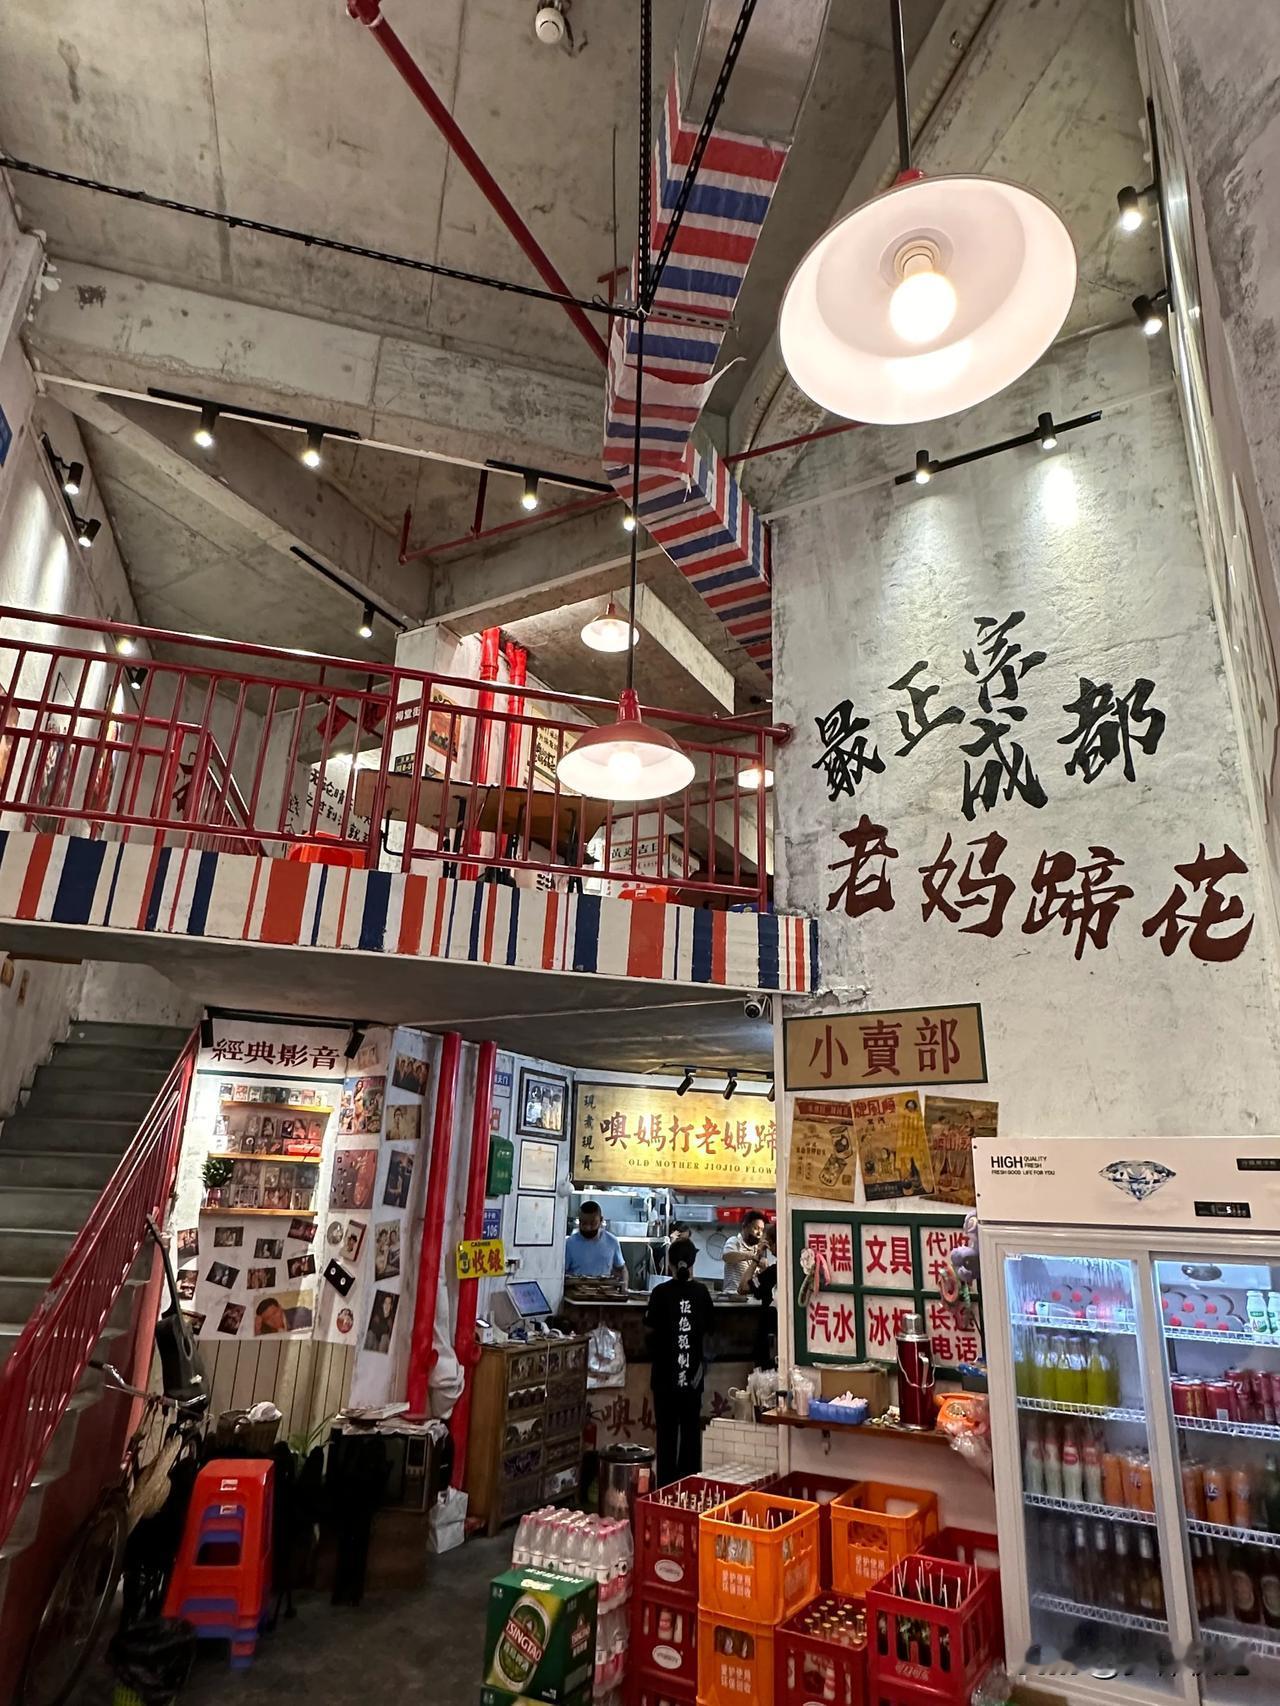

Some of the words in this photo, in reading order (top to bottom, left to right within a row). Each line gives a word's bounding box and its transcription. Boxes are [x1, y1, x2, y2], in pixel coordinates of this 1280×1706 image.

[827, 814, 1254, 961] 老妈蹄花
[211, 1038, 340, 1070] 經典影音
[808, 1016, 961, 1079] 小賣部
[629, 1159, 650, 1167] OLD
[655, 1160, 699, 1170] MOTHER
[704, 1163, 741, 1172] JIOJIO
[990, 1156, 1023, 1169] HIGH
[808, 1234, 852, 1272] 雪糕
[865, 1235, 912, 1275] 文具
[810, 1302, 854, 1343] 汽水
[931, 1335, 978, 1362] 电话
[505, 1620, 542, 1662] TSINGTAO
